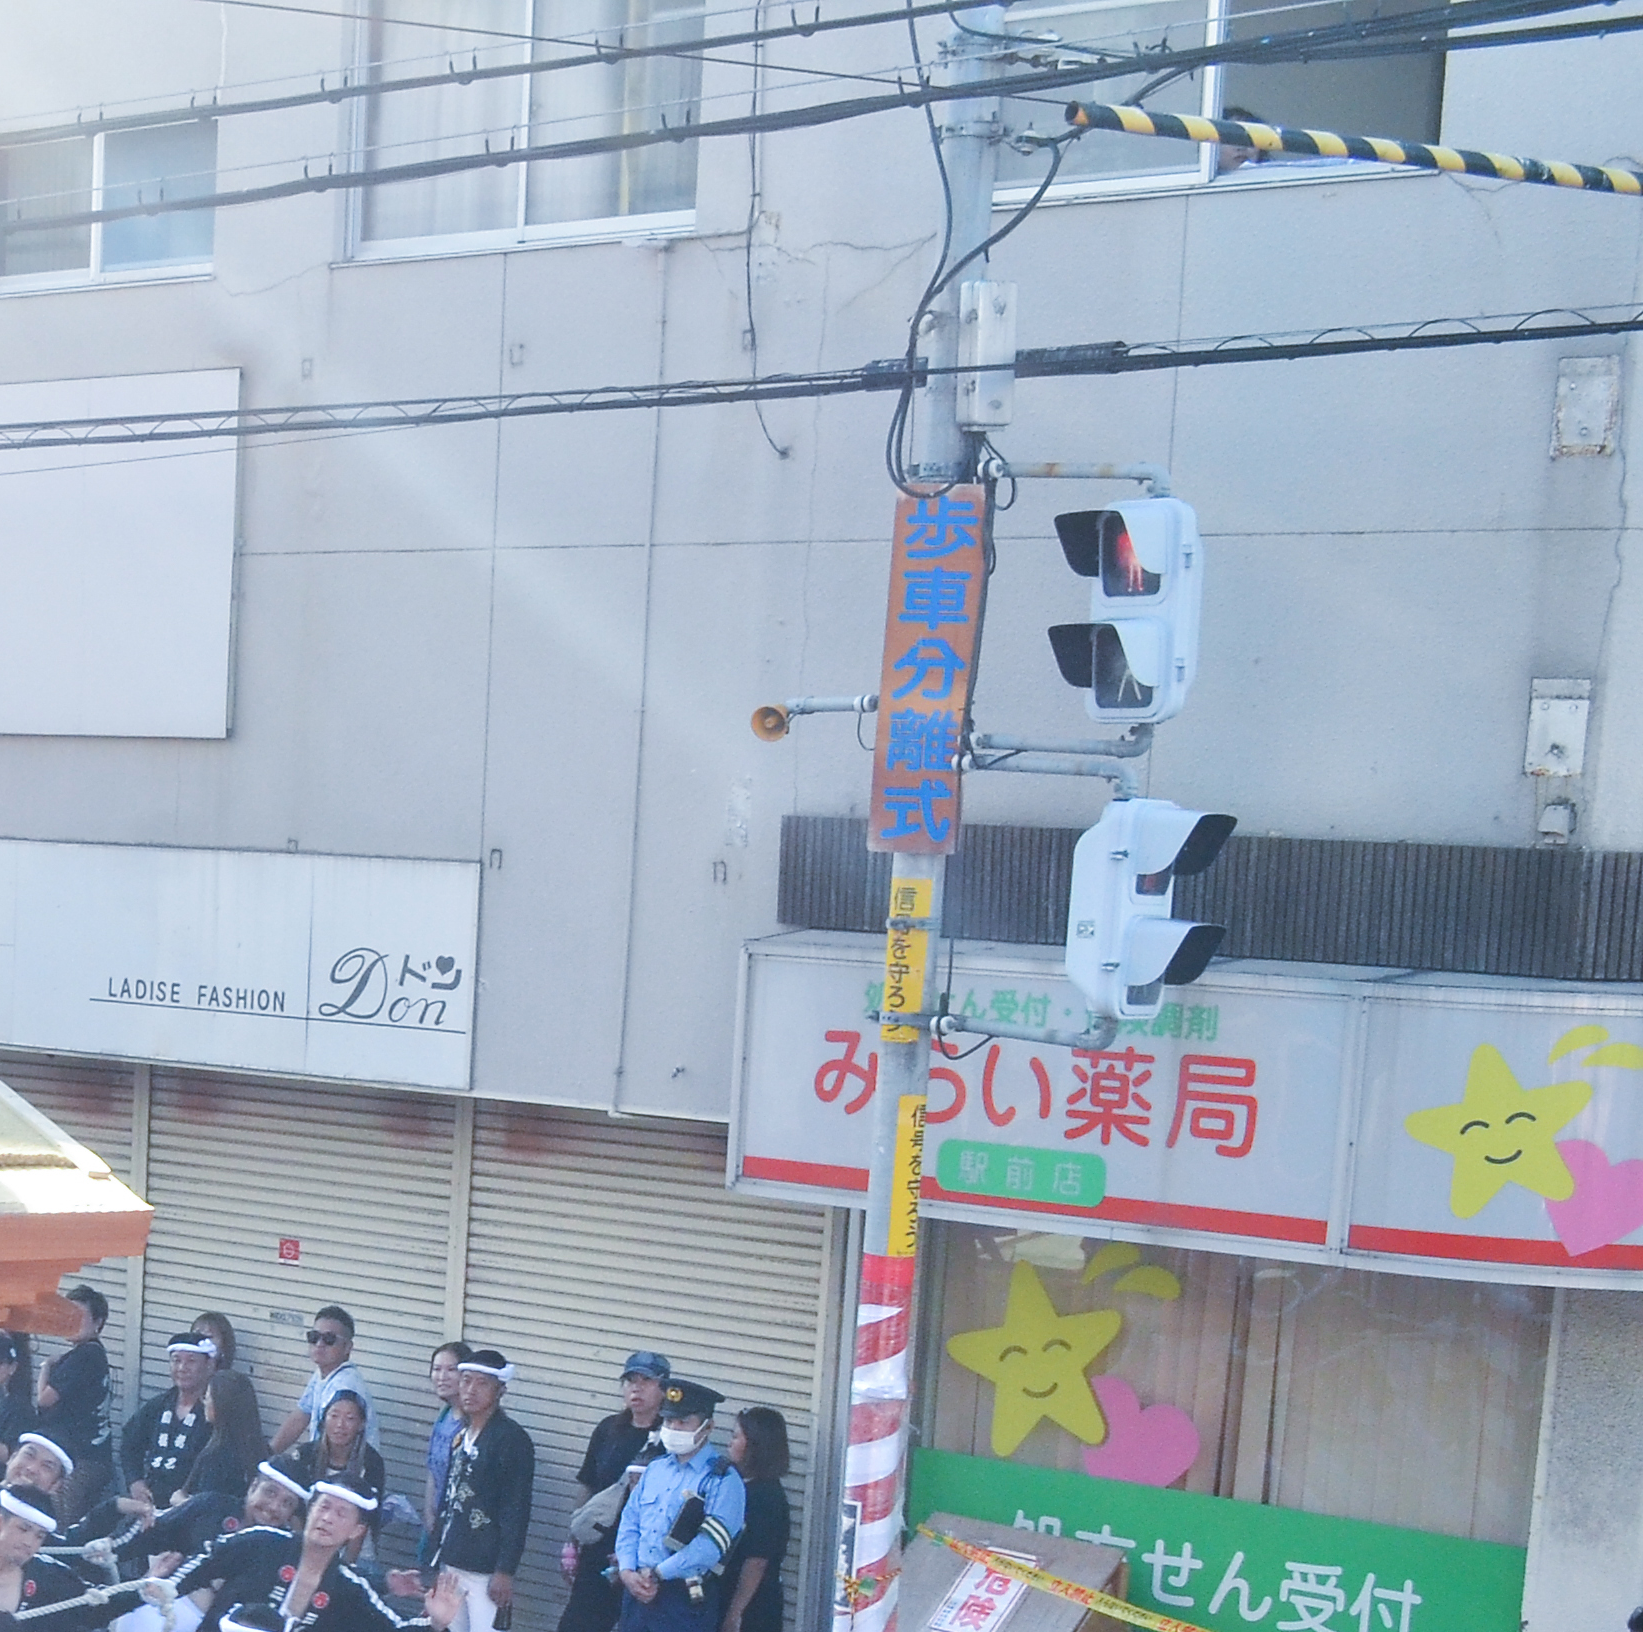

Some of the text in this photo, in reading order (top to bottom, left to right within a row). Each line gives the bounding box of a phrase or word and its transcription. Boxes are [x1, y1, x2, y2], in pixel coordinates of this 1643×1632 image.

[880, 495, 979, 843] 歩車分離式
[108, 977, 286, 1013] LADISE FASHION
[318, 946, 448, 1026] Don
[957, 1149, 1084, 1196] 駅前店
